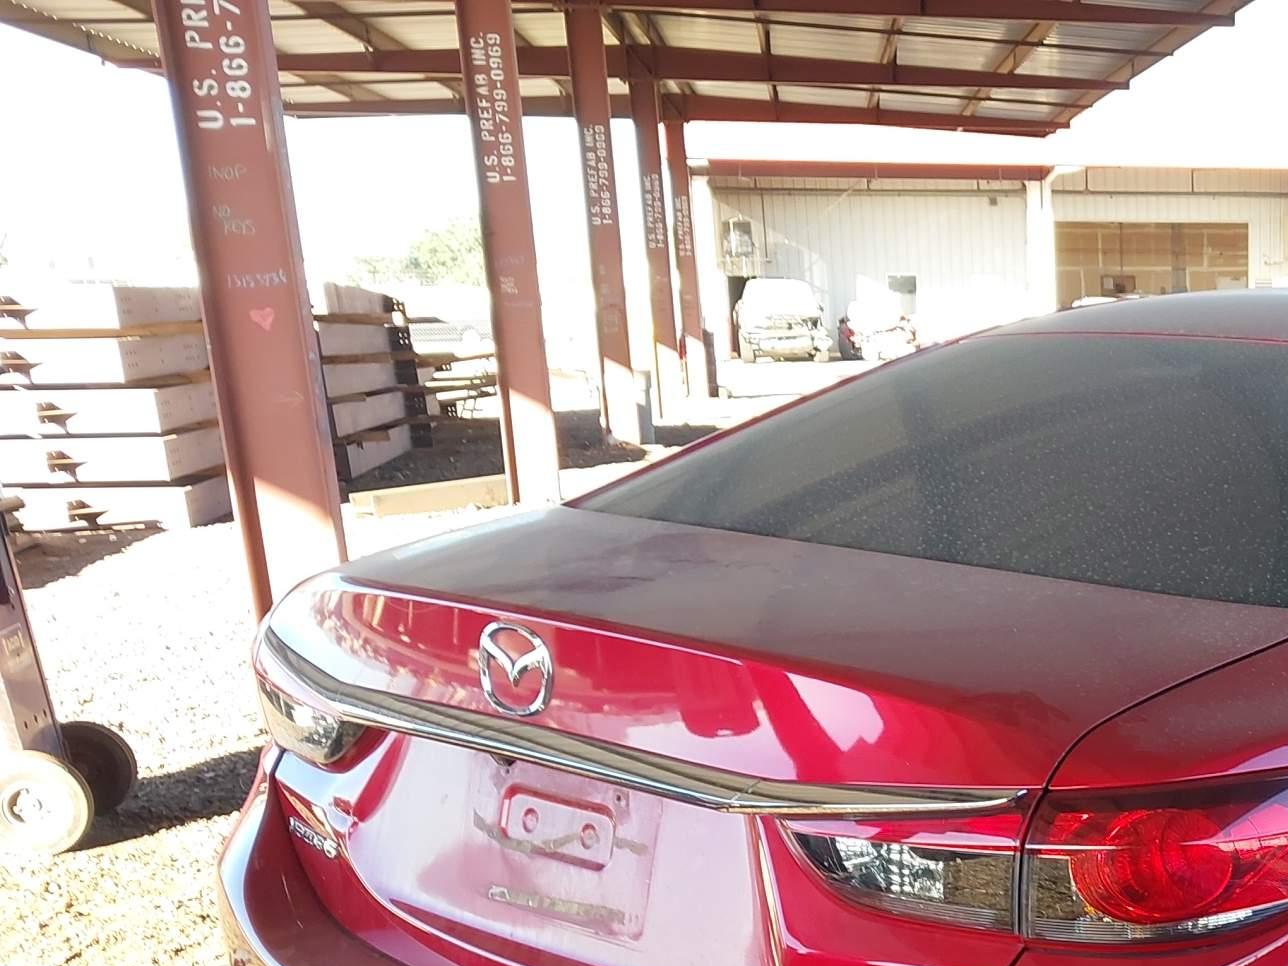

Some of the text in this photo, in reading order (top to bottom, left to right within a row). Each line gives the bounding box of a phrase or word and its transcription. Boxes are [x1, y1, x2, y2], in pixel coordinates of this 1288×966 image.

[192, 68, 224, 129] U.S.
[470, 31, 500, 184] U.S. PREFAB INC.
[487, 32, 517, 182] 1-866-799-0969
